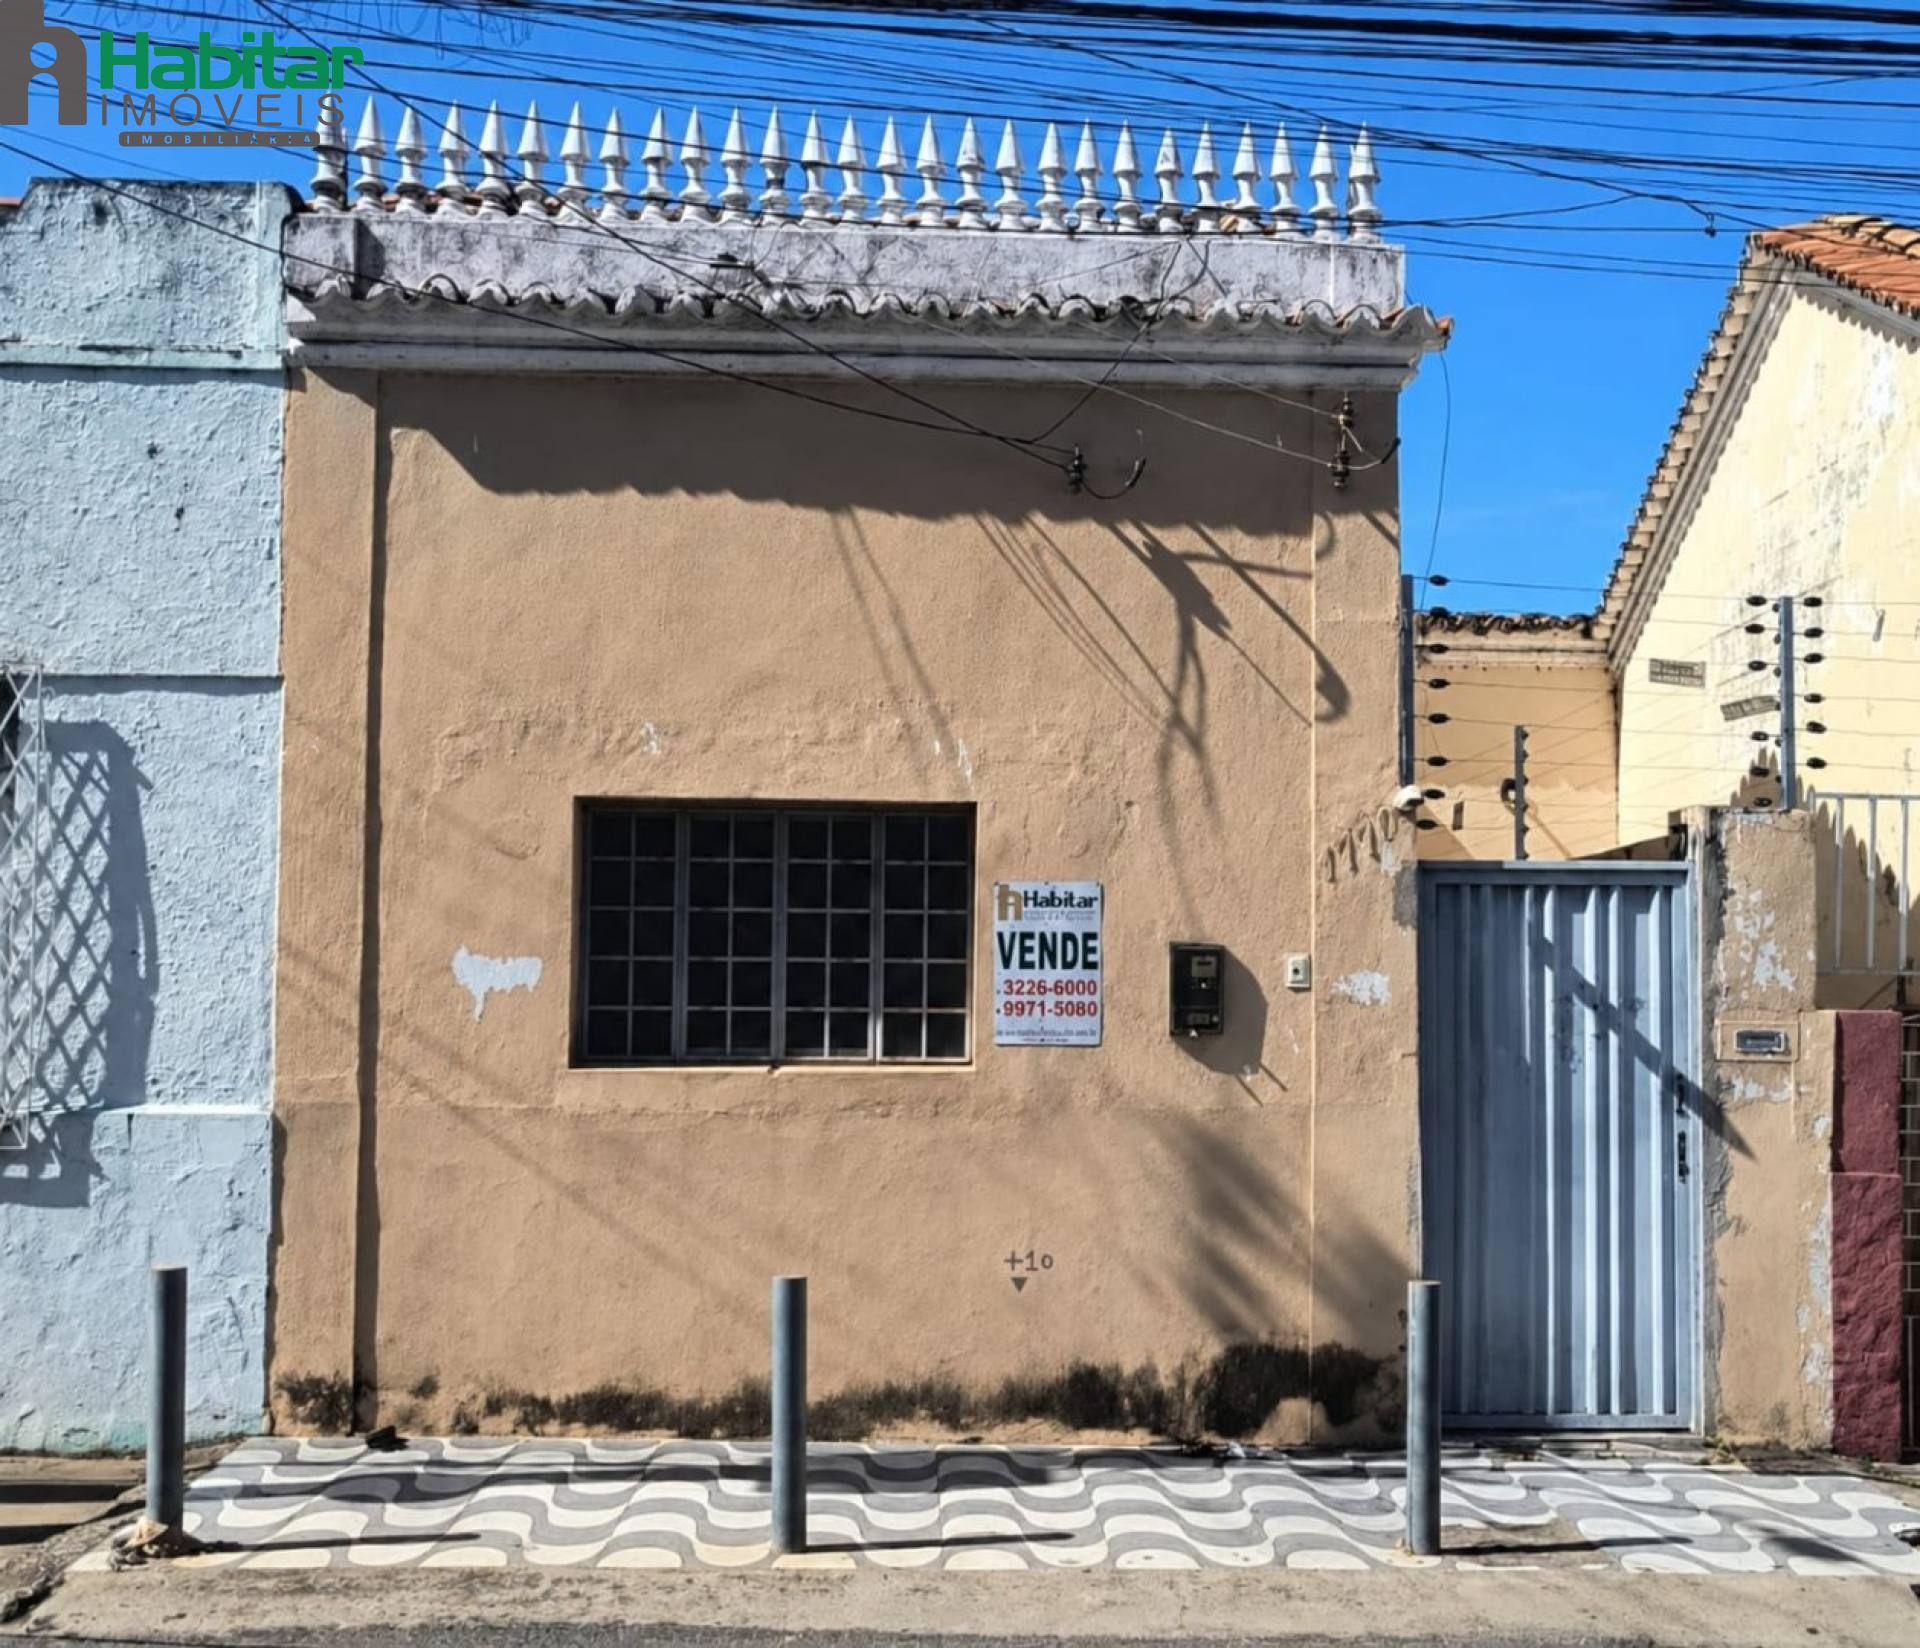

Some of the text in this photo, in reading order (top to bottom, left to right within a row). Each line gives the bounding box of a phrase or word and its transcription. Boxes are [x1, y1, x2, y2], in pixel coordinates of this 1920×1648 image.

[1024, 890, 1099, 909] Habitar
[996, 931, 1099, 970] VENDE
[1003, 979, 1097, 996] 3226-6000
[1003, 1000, 1097, 1017] 9971-5080
